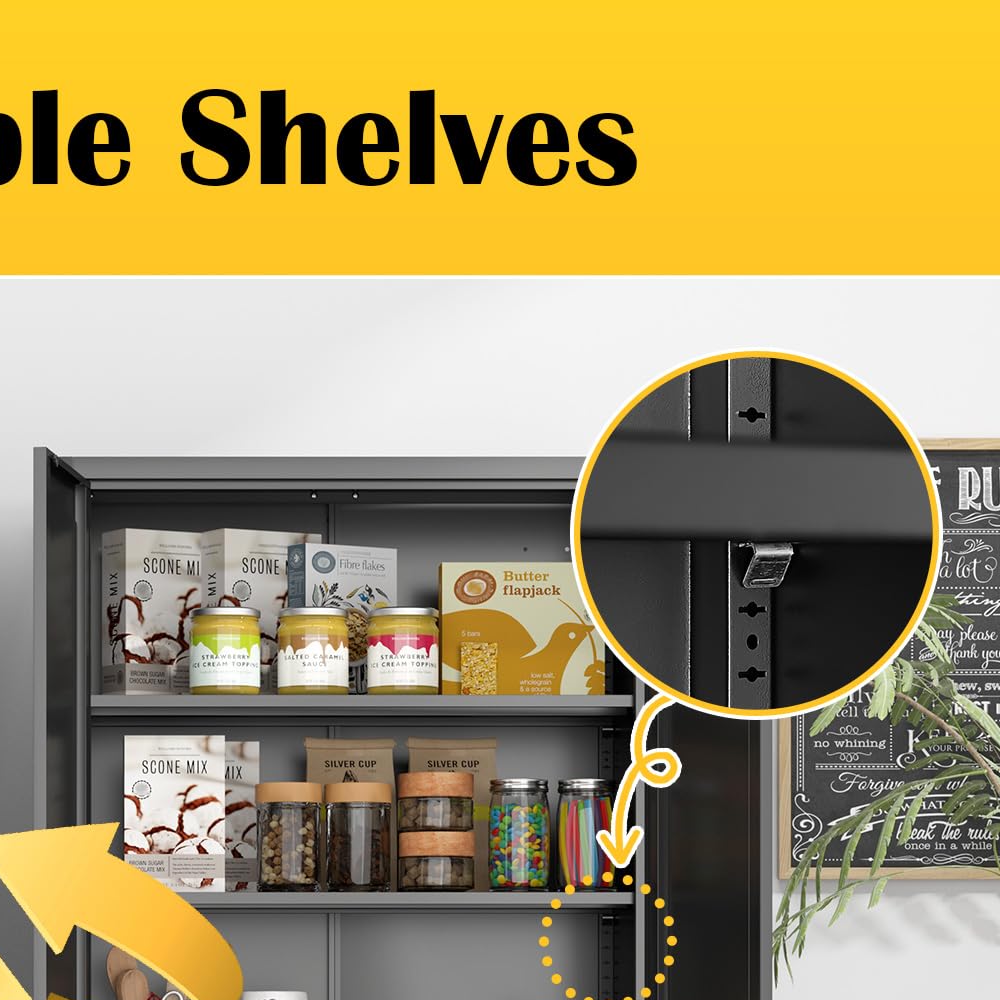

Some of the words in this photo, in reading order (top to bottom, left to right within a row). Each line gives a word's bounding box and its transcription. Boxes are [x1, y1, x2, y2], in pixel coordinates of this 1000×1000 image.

[143, 557, 182, 576] SCONE
[242, 557, 280, 576] SCONE
[339, 558, 360, 570] Fibre
[362, 560, 386, 571] flakes
[503, 571, 550, 582] Butter
[109, 572, 118, 597] MIX
[208, 572, 217, 597] MIX
[503, 585, 561, 598] flapjack
[960, 624, 999, 648] please
[834, 738, 887, 749] whining
[928, 744, 954, 752] YOUR
[141, 759, 181, 774] SCONE
[186, 759, 208, 774] MIX
[324, 760, 355, 768] SILVER
[358, 760, 377, 768] CUP
[427, 760, 458, 768] SILVER
[461, 760, 480, 768] CUP
[934, 842, 946, 850] in
[961, 841, 993, 850] while
